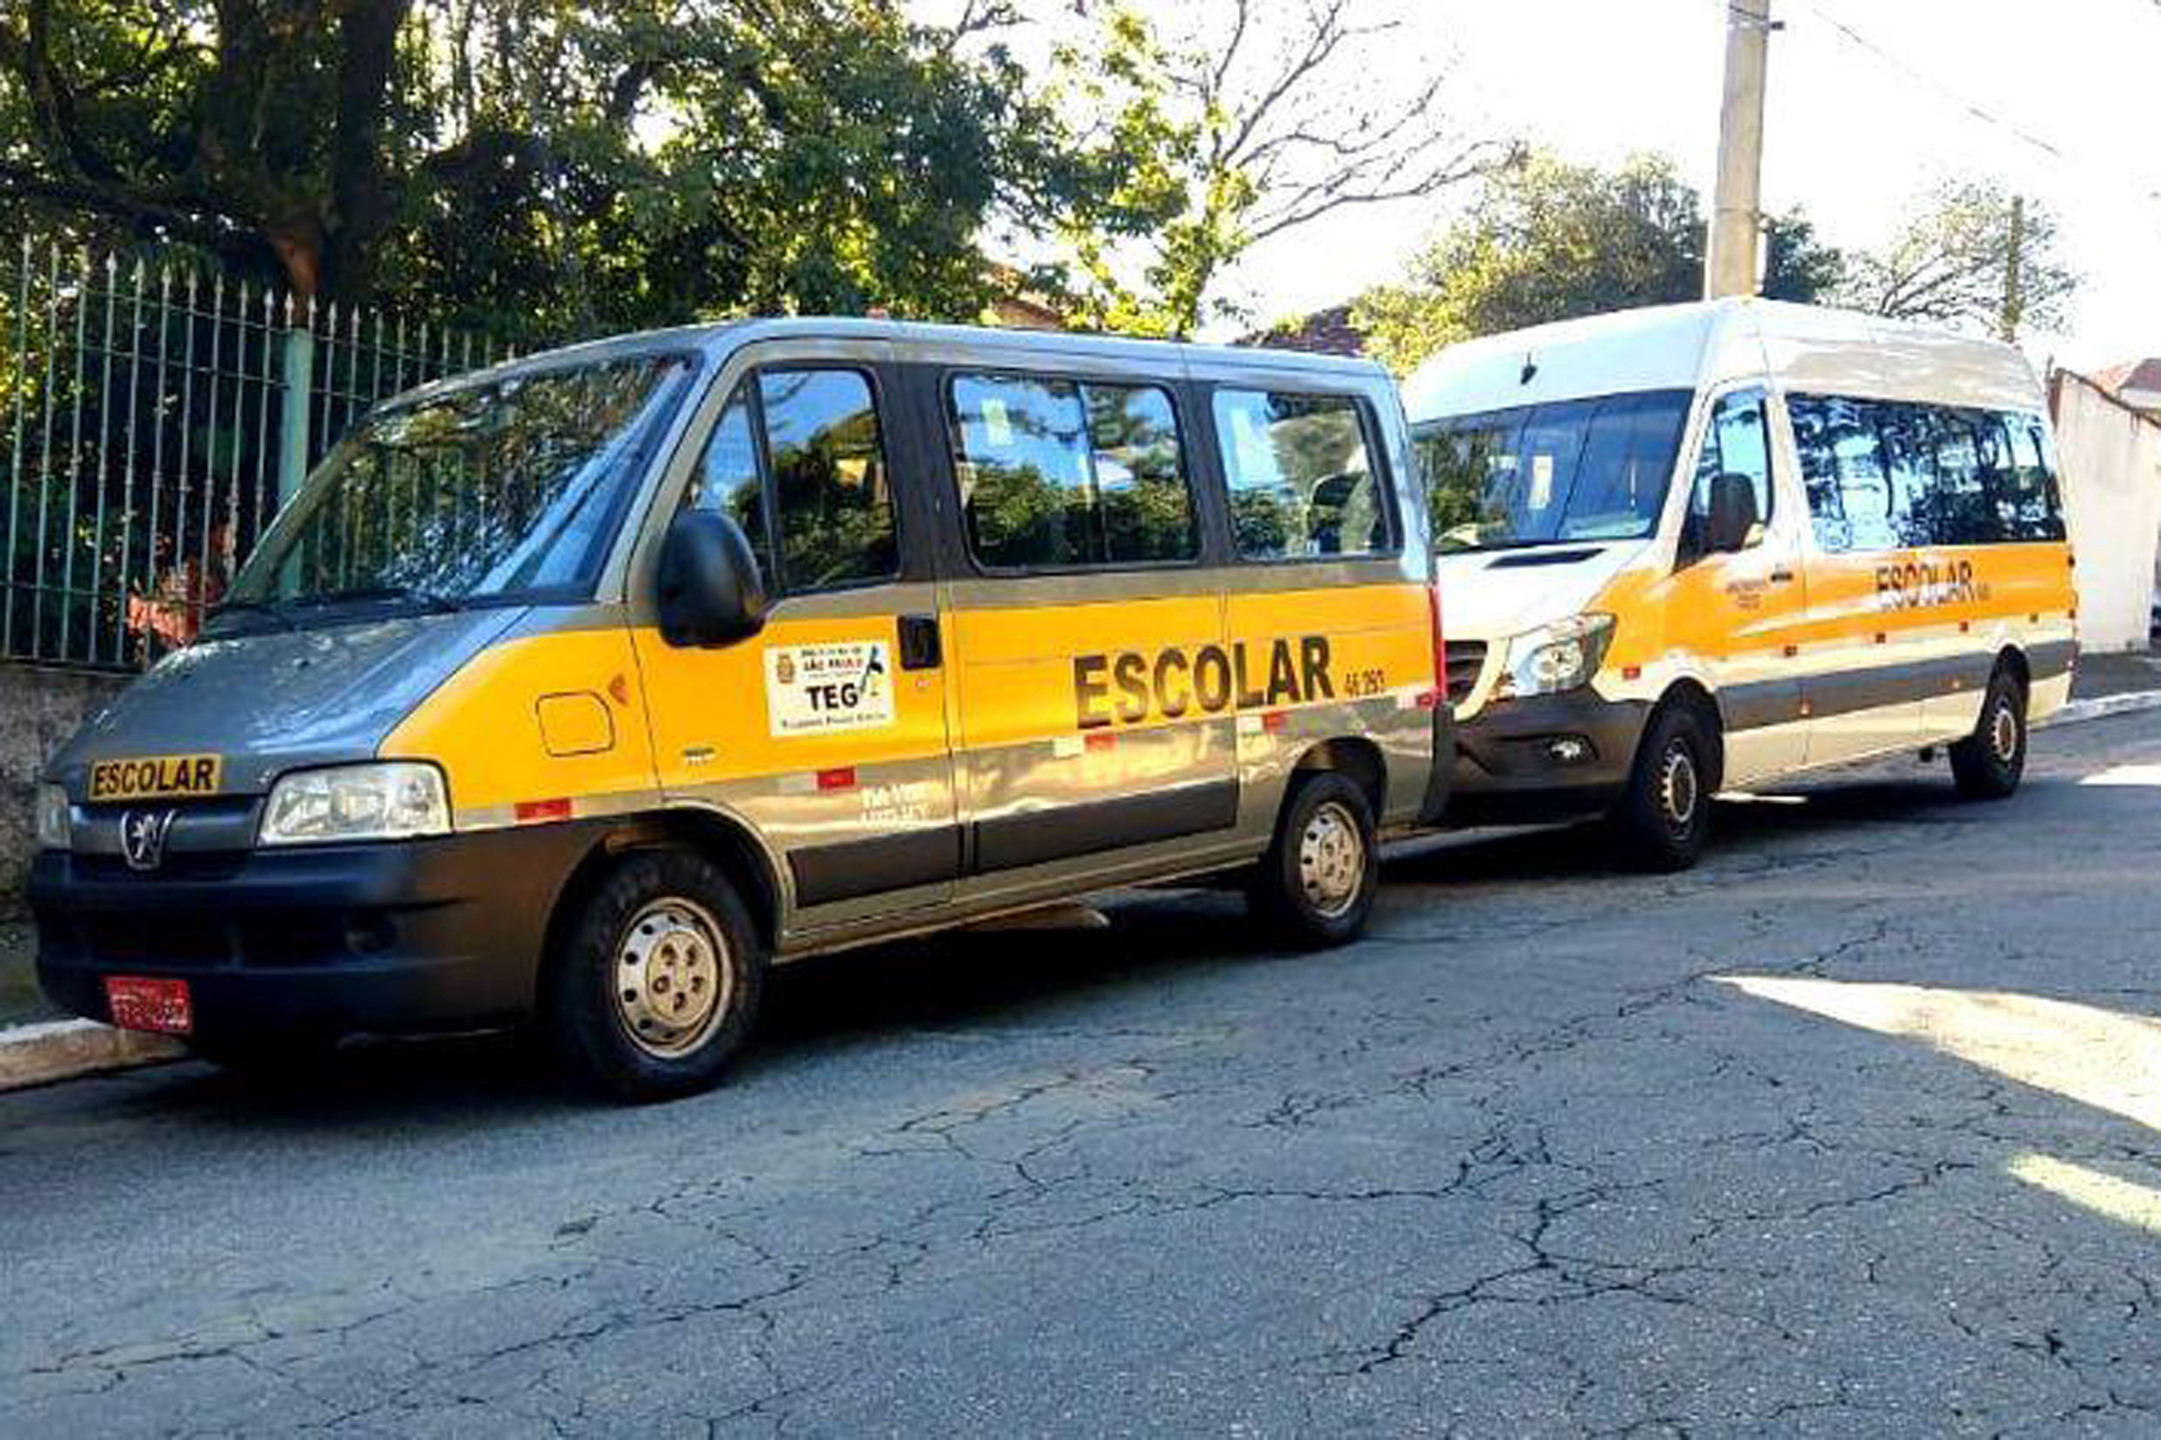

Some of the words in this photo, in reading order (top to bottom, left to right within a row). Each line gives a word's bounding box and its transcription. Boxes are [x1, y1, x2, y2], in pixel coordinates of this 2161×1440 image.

[1875, 559, 1975, 608] ESCOLAR
[804, 682, 858, 711] TEG
[1074, 636, 1335, 730] ESCOLAR
[93, 758, 215, 796] ESCOLAR
